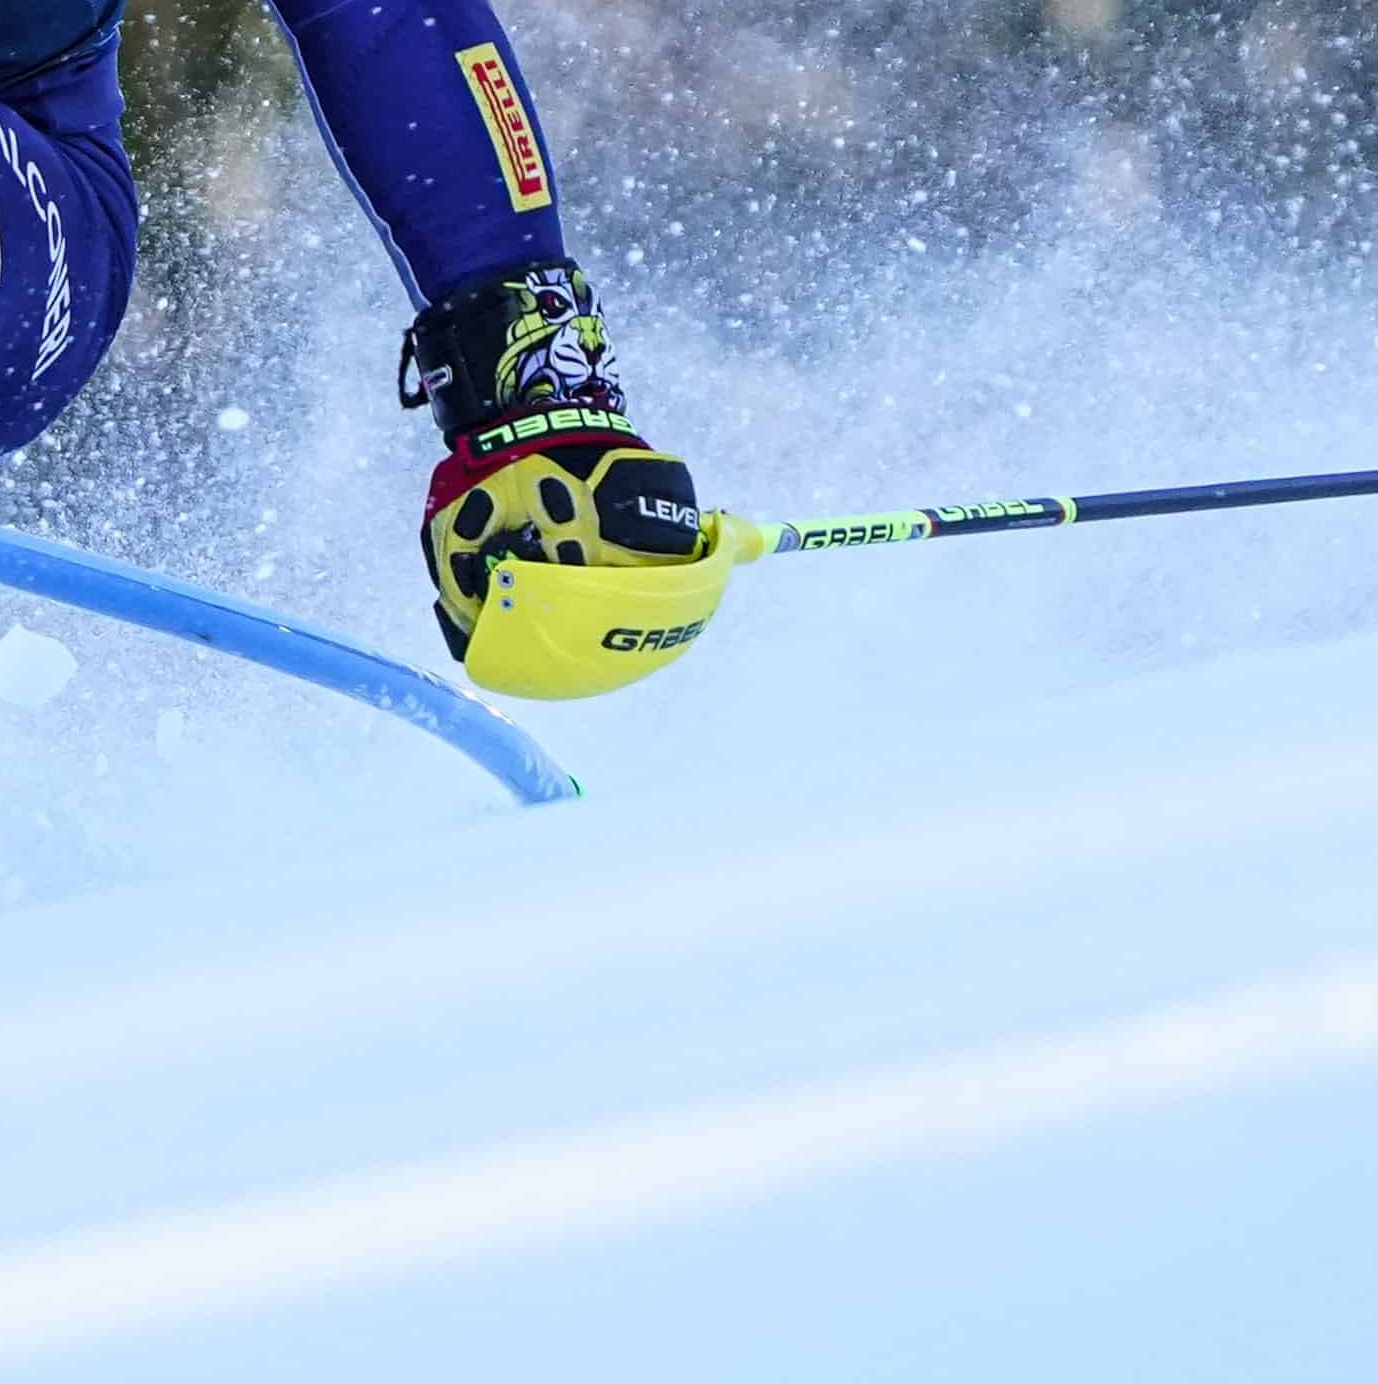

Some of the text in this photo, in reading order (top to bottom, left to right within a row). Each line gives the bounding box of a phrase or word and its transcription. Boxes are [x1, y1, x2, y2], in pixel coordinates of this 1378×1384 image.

[472, 59, 543, 196] PIRELLI
[477, 407, 638, 445] GABEL
[601, 618, 703, 652] GABE
